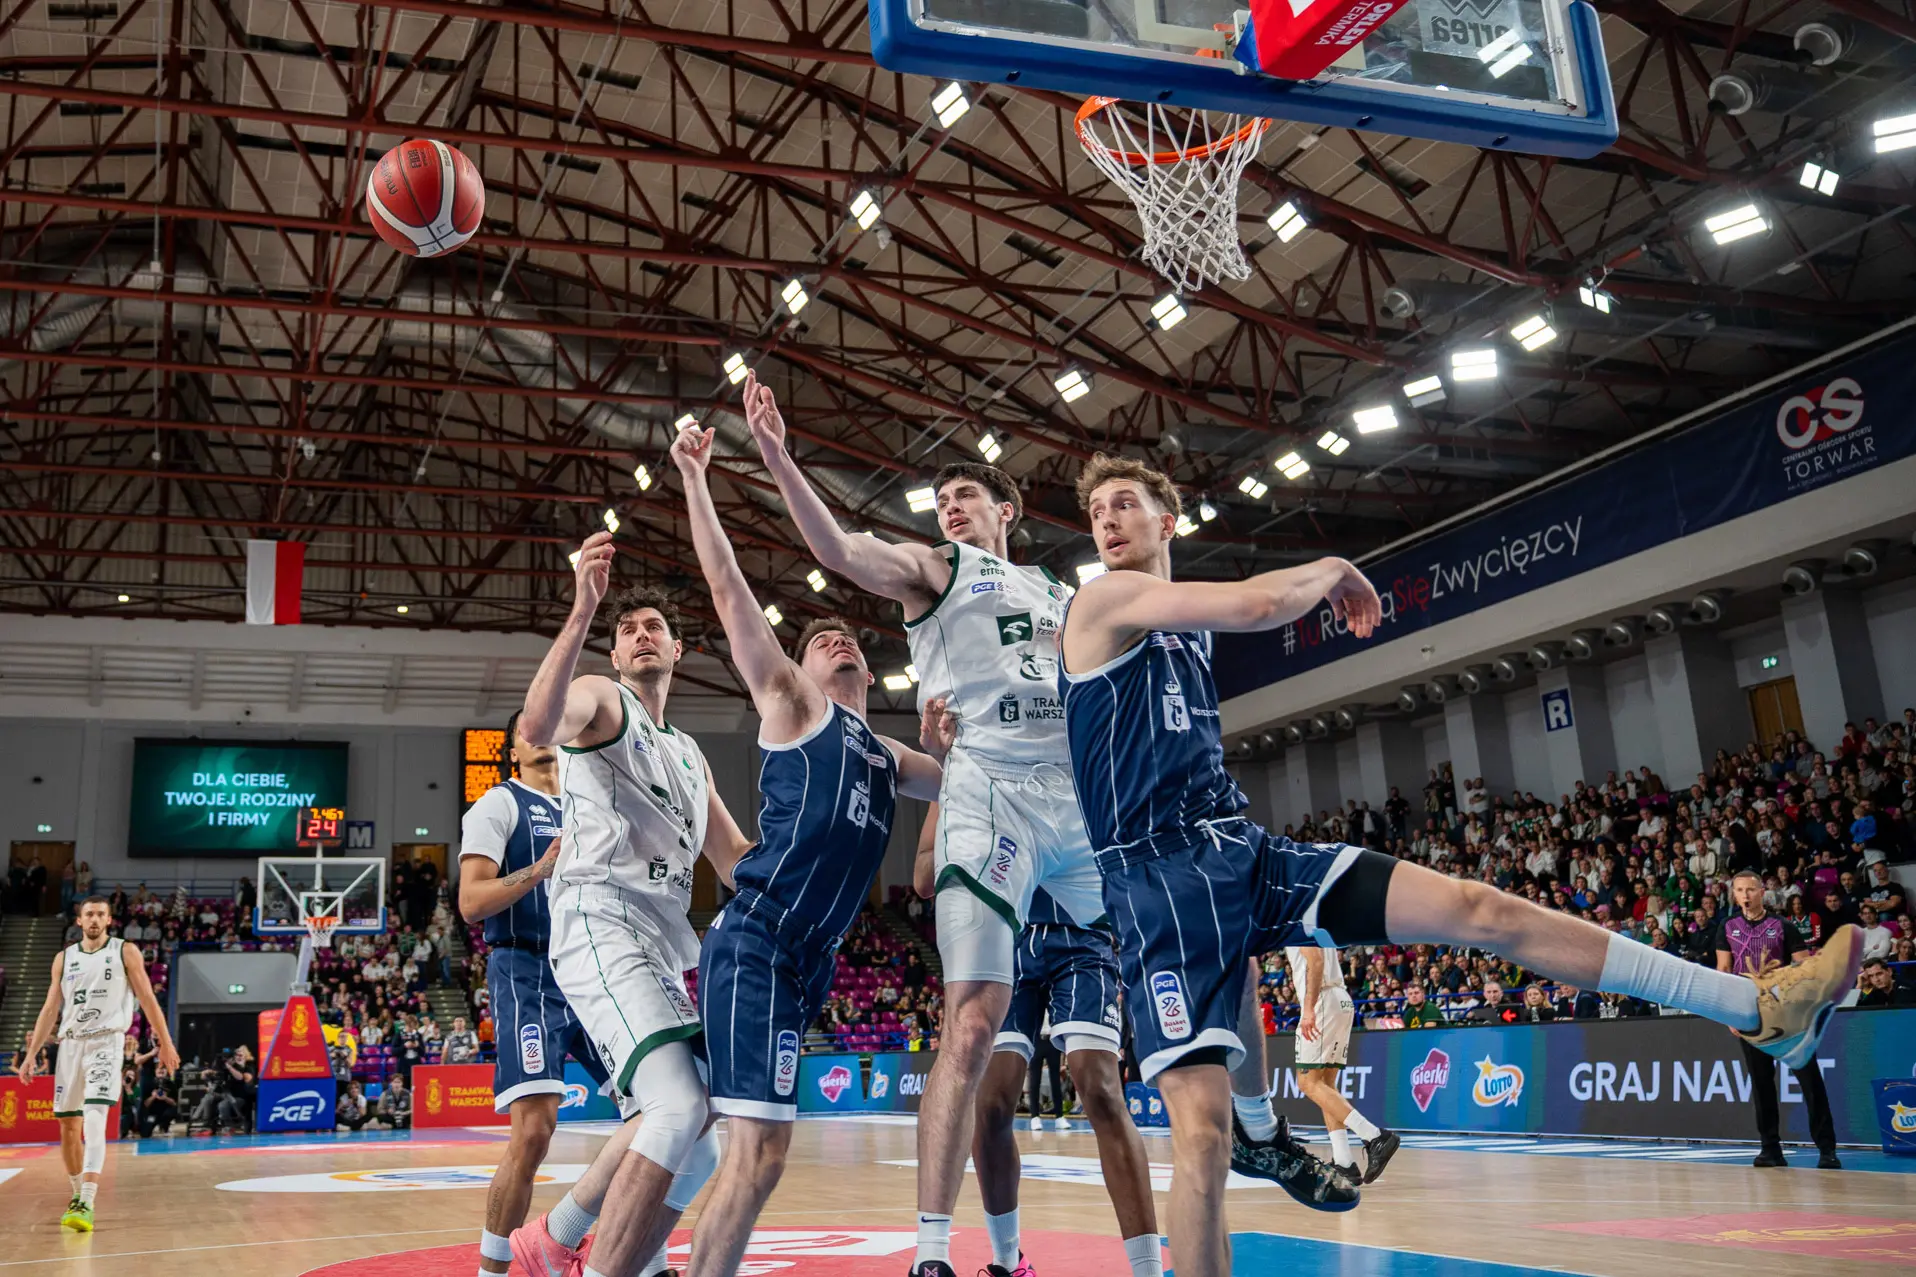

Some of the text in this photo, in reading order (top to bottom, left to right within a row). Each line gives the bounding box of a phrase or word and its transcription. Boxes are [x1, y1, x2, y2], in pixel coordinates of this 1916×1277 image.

[1314, 0, 1375, 46] TERMIKA
[1335, 2, 1393, 46] ORLEN
[1784, 437, 1876, 482] TORWAR
[1283, 515, 1582, 656] #TuRoąSięZwycięzcy
[1547, 699, 1569, 729] R
[192, 772, 290, 788] DLA CIEBIE,
[164, 791, 316, 807] TWOJEJ RODZINY
[217, 812, 271, 826] FIRMY
[307, 820, 337, 838] 24
[350, 826, 371, 848] M
[104, 968, 112, 981] 6
[1155, 979, 1175, 990] PGE
[1164, 1019, 1186, 1027] Basket
[1283, 1066, 1372, 1099] NET
[1412, 1062, 1449, 1086] Gierki
[1568, 1060, 1661, 1102] GRAJ
[1484, 1074, 1513, 1097] LOTTO
[268, 1105, 315, 1122] PGE
[1900, 1115, 1916, 1127] LO
